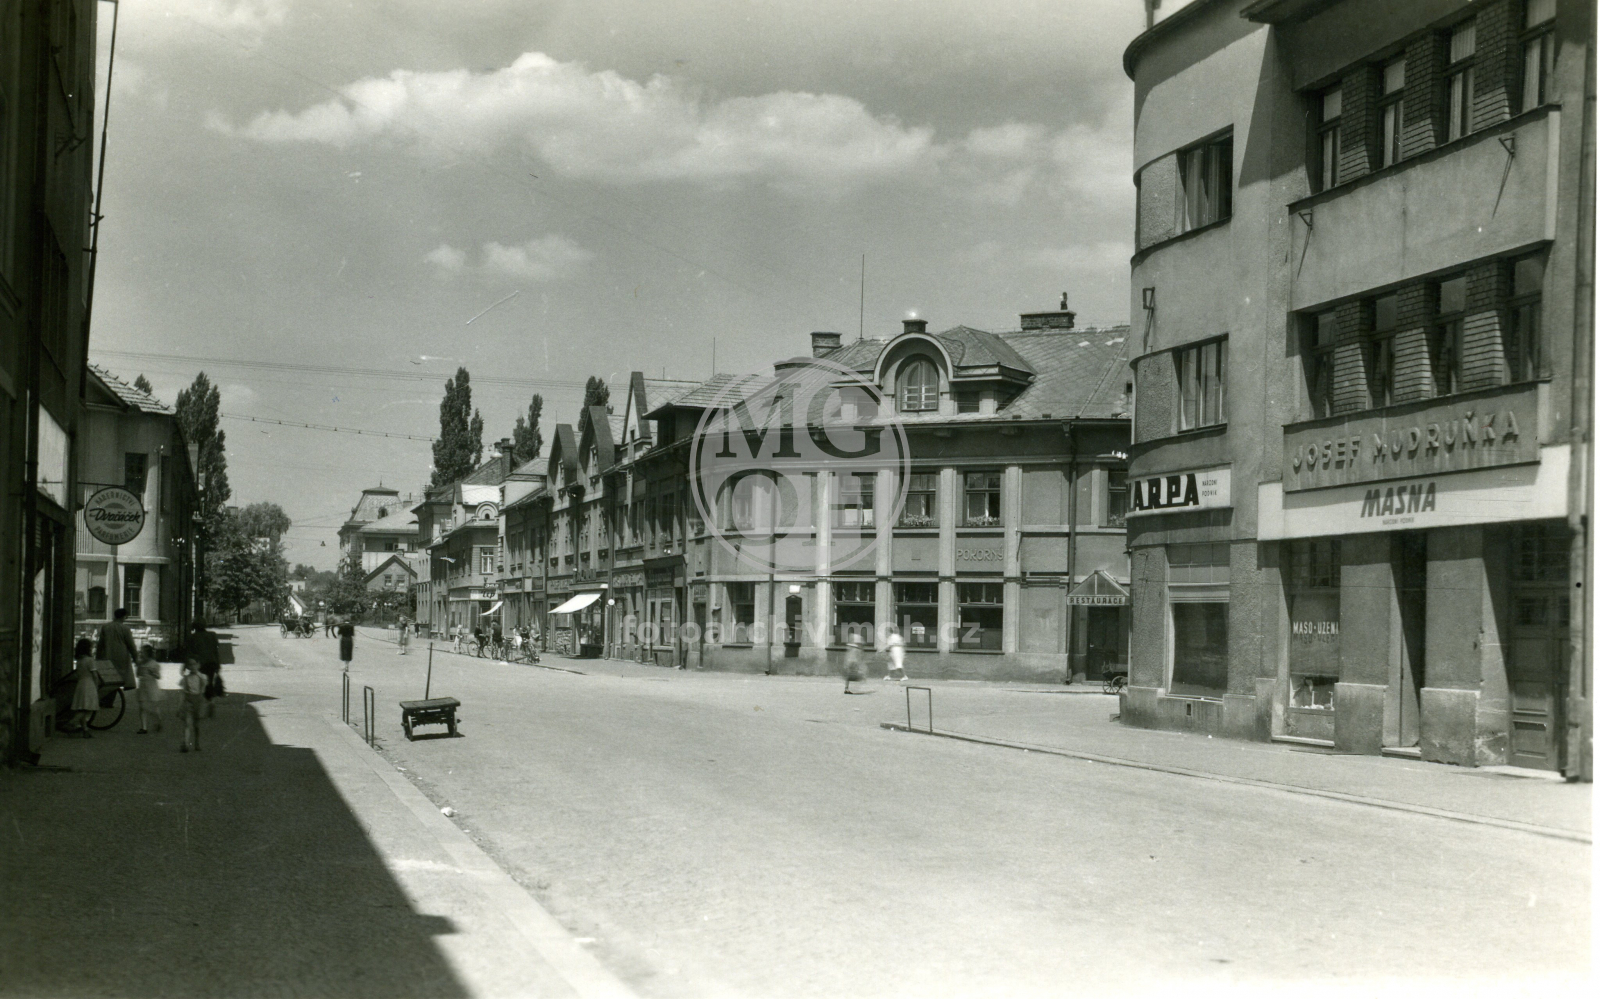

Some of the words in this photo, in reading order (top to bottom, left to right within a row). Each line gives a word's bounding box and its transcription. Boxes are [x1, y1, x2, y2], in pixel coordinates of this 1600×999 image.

[1293, 434, 1360, 473] JOSEF
[1373, 410, 1519, 464] MUDRUŇKA
[1361, 482, 1436, 518] MASNA
[1069, 597, 1123, 605] RESTAURACE
